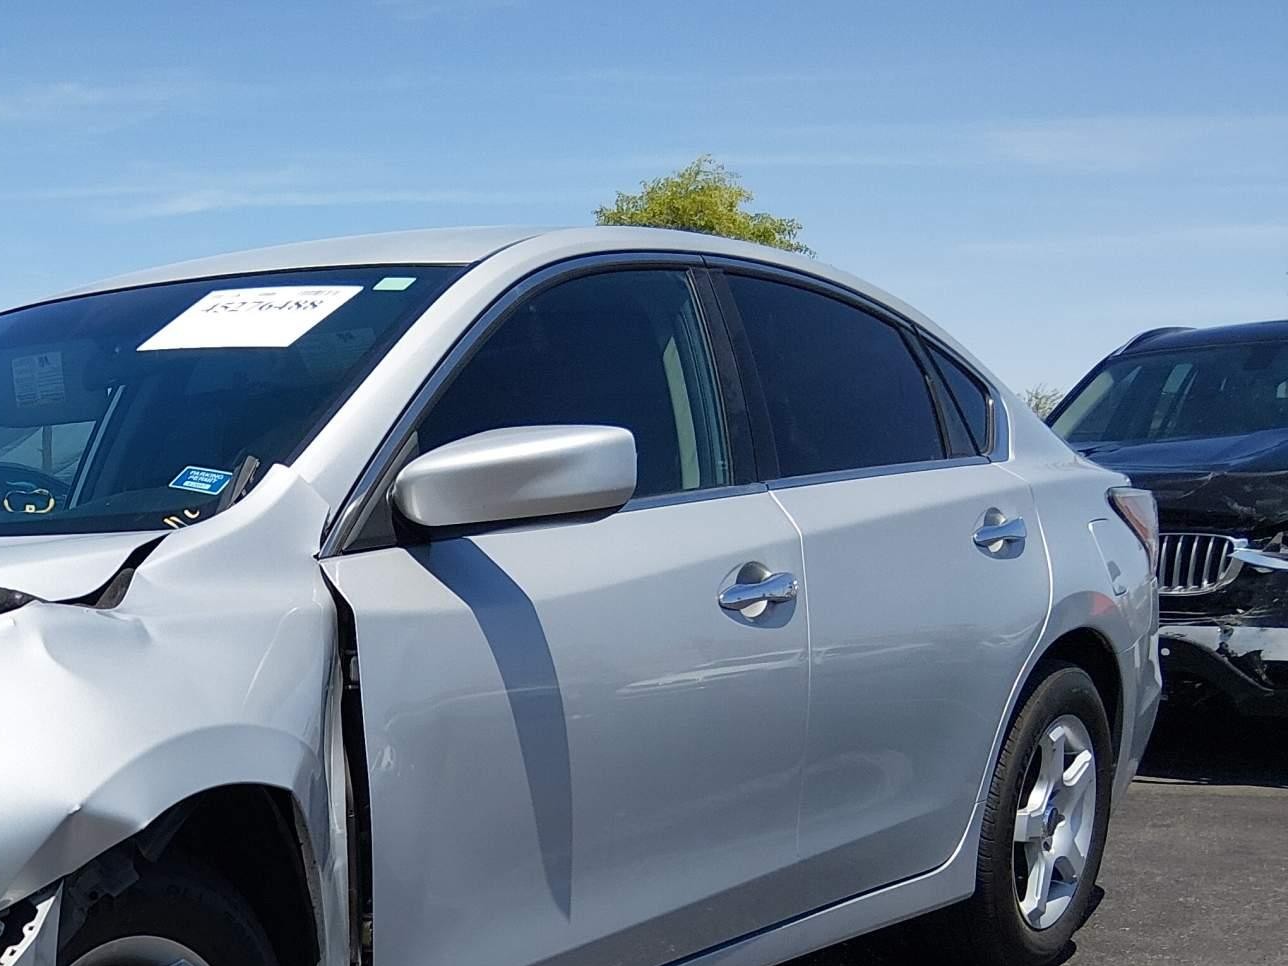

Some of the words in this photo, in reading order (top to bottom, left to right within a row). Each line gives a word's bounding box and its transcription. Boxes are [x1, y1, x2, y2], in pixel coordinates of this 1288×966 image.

[201, 299, 324, 313] 45276488
[187, 475, 218, 484] PERMIT
[189, 470, 224, 480] PARKING
